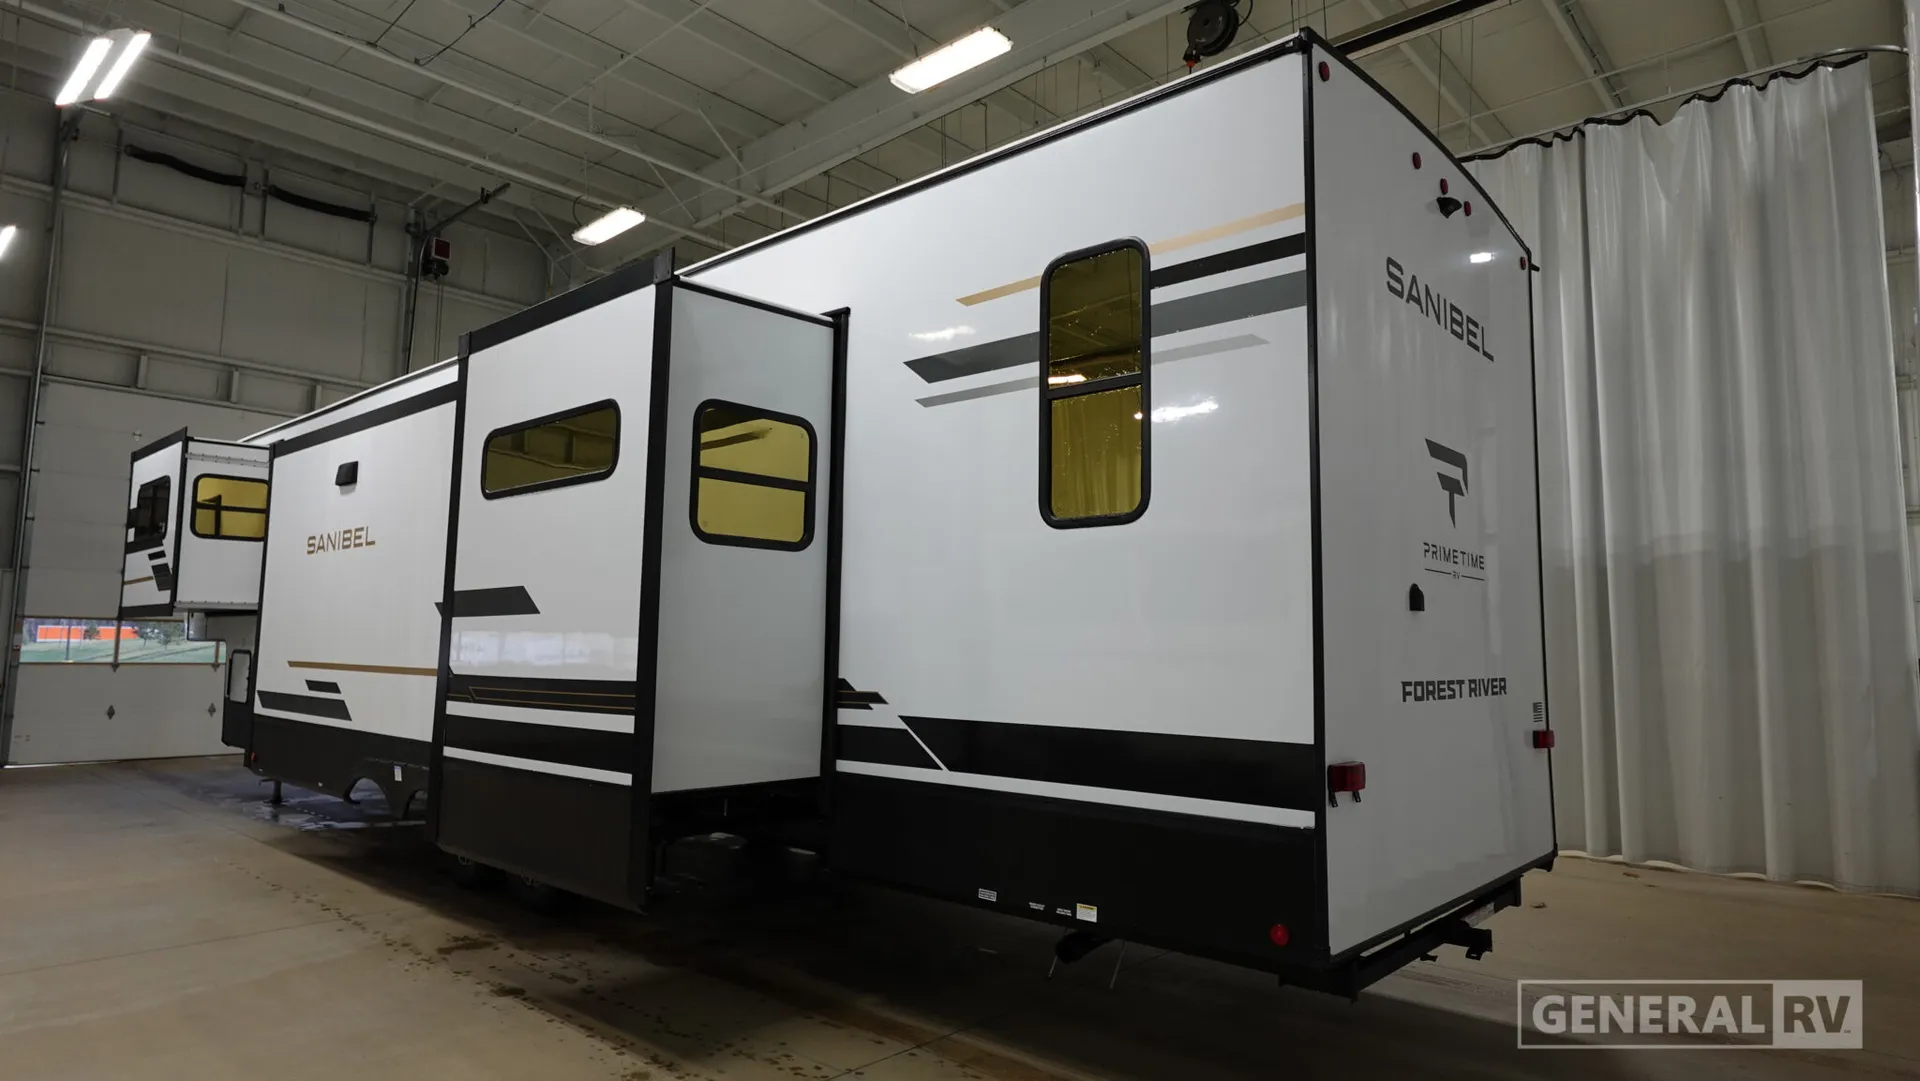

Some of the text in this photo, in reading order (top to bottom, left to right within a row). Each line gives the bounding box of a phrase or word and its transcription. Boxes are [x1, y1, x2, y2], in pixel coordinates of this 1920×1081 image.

[1386, 256, 1495, 363] SANIBEL
[306, 525, 376, 555] SANIBEL
[1401, 677, 1507, 702] FOREST RIVER
